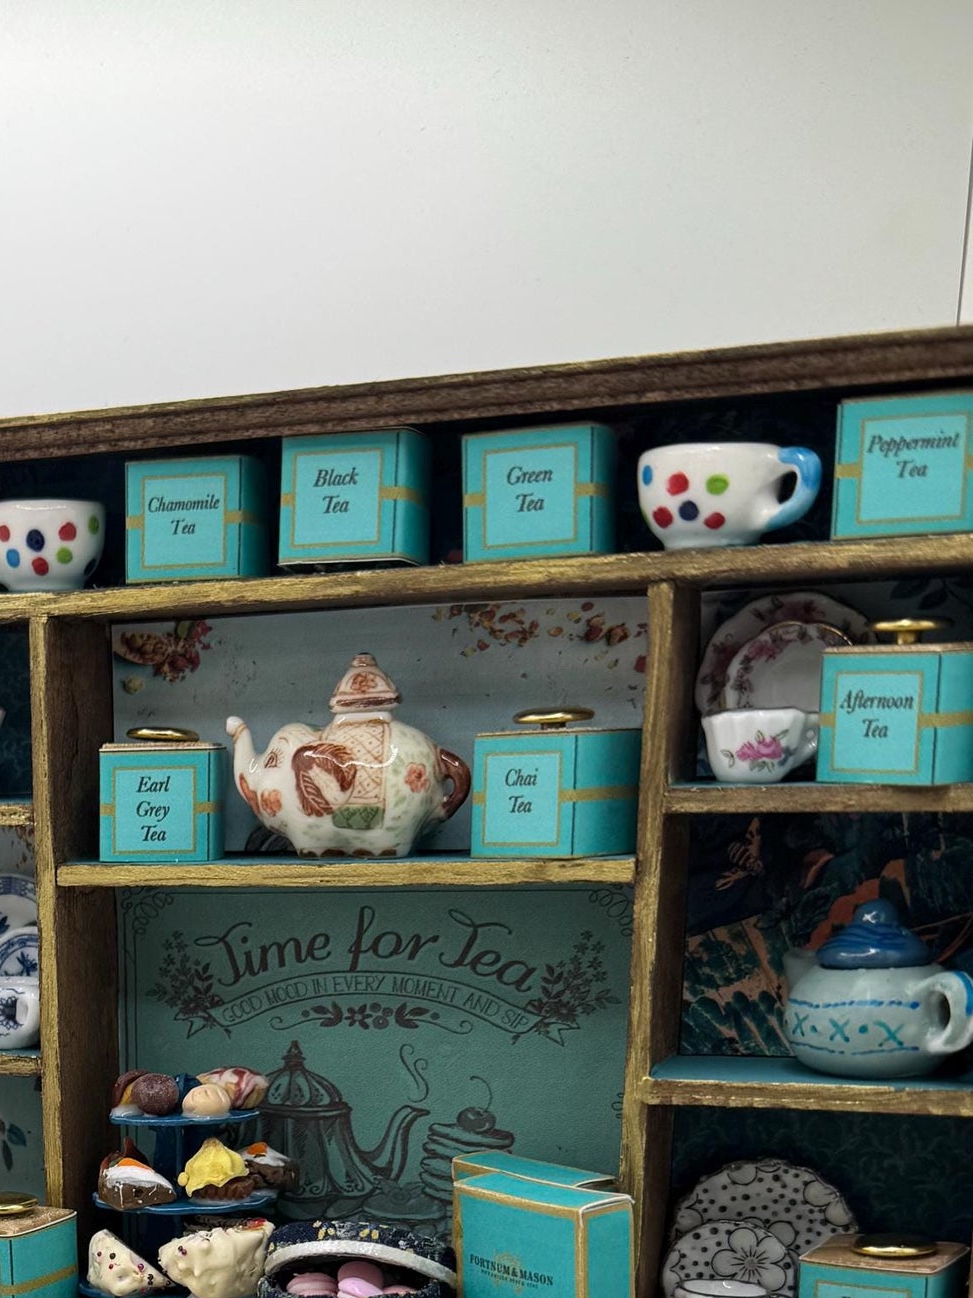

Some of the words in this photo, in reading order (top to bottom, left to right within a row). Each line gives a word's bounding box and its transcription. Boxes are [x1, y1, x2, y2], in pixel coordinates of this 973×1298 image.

[865, 430, 960, 455] Peppermint
[314, 466, 359, 489] Black
[506, 465, 553, 486] Green
[896, 458, 928, 478] Tea
[147, 494, 221, 514] Chamomile
[322, 495, 349, 515] Tea
[515, 492, 545, 512] Tea
[171, 518, 197, 537] Tea
[839, 689, 914, 714] Afternoon
[861, 717, 889, 739] Tea
[136, 775, 171, 794] Earl
[505, 767, 538, 788] Chai
[135, 799, 170, 821] Grey
[508, 795, 533, 815] Tea
[141, 823, 167, 843] Tea
[194, 922, 332, 987] Time
[348, 905, 440, 972] for
[438, 908, 538, 992] Tea
[222, 995, 263, 1023] GOOD
[265, 981, 308, 1006] MOOD
[312, 976, 328, 995] IN
[332, 975, 386, 993] EVERY
[391, 976, 460, 1003] MOMENT
[462, 992, 501, 1017] AND
[501, 1008, 529, 1029] SIP
[469, 1253, 510, 1277] FORTNUM
[519, 1268, 554, 1286] MASON
